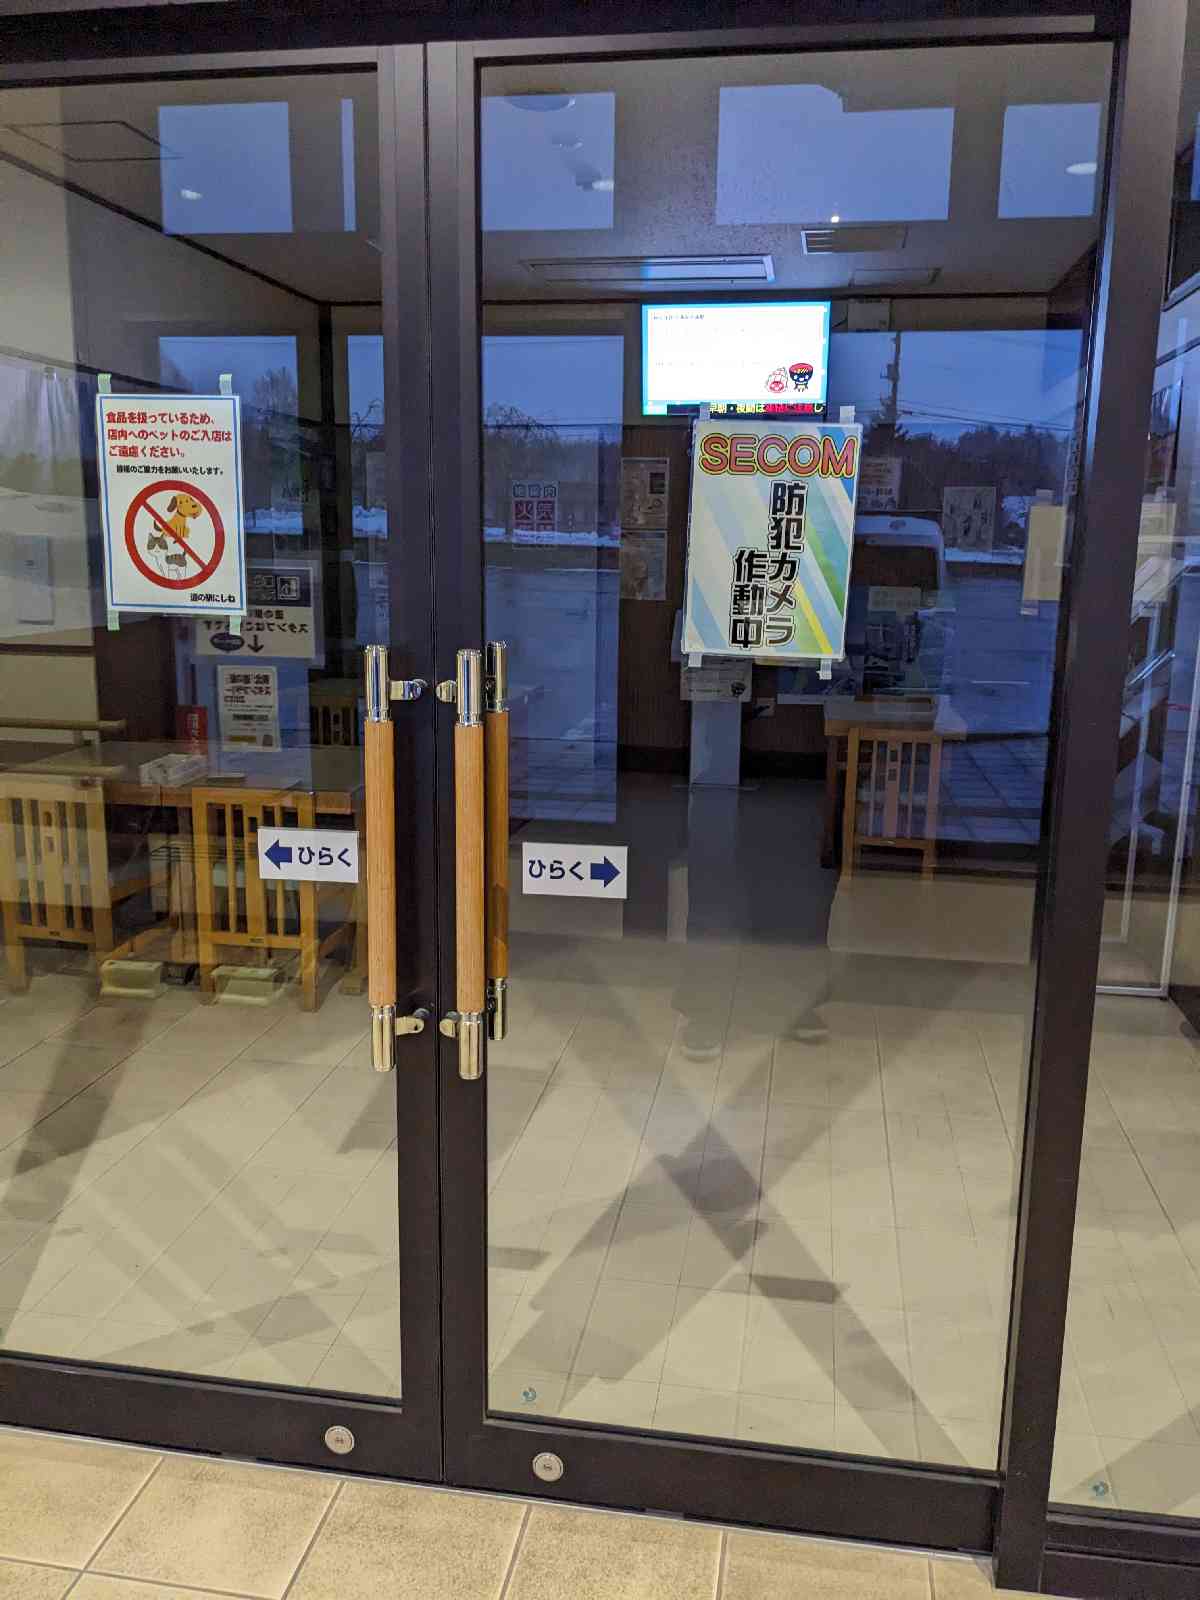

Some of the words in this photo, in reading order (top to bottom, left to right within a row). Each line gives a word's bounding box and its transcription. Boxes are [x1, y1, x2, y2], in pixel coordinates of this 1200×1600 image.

[106, 411, 215, 425] 食品を扱っているため、
[107, 428, 233, 442] 店内へのペットのご入店は
[108, 445, 185, 458] ご遠慮ください。
[699, 432, 857, 479] SECOM
[766, 479, 808, 648] 防犯カメラ
[729, 547, 769, 649] 作動中
[297, 845, 352, 868] ひらく
[527, 858, 585, 881] ひらく
